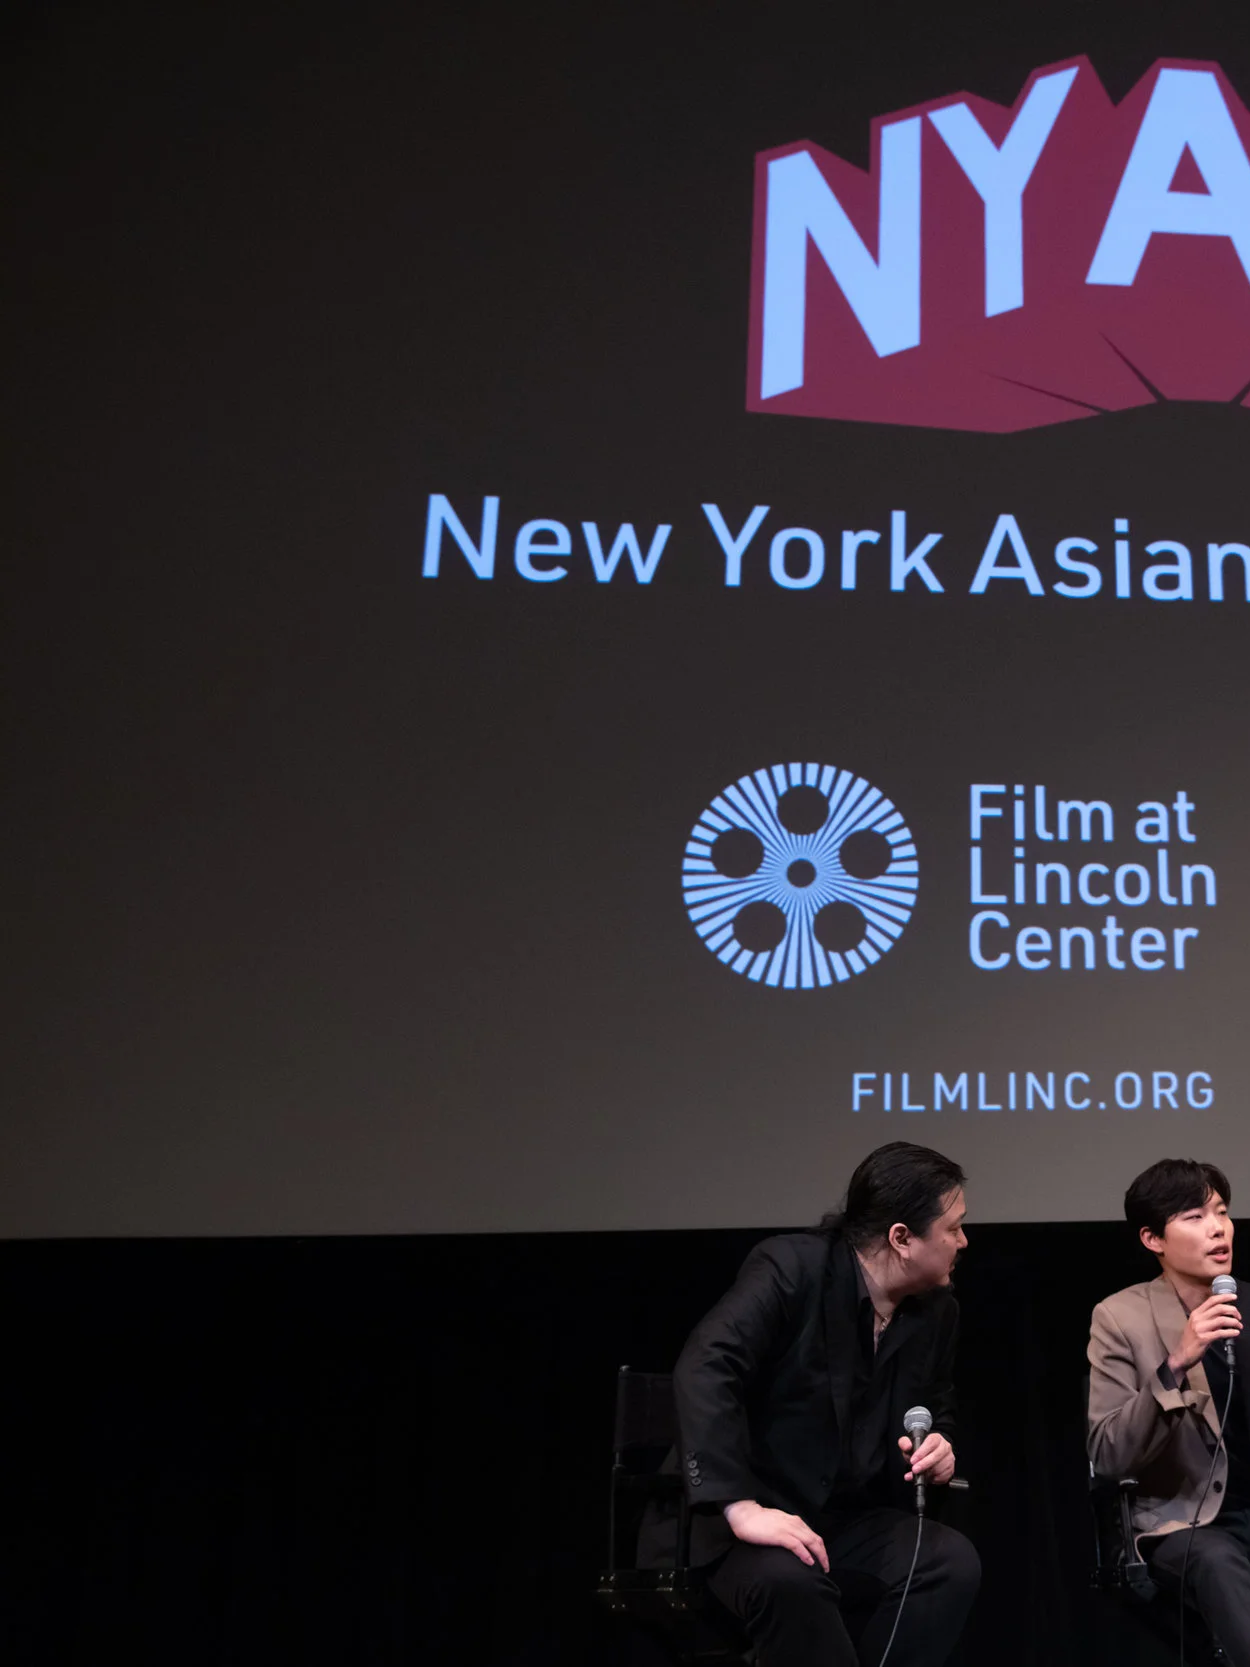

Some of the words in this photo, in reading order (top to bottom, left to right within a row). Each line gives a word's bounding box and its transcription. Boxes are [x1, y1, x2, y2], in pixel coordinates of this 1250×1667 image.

[423, 494, 672, 584] New
[702, 503, 945, 593] York
[969, 783, 1115, 843] Film
[1134, 790, 1196, 844] at
[969, 846, 1218, 907] Lincoln
[969, 910, 1199, 971] Center
[852, 1071, 1215, 1112] FILMLINC.ORG
